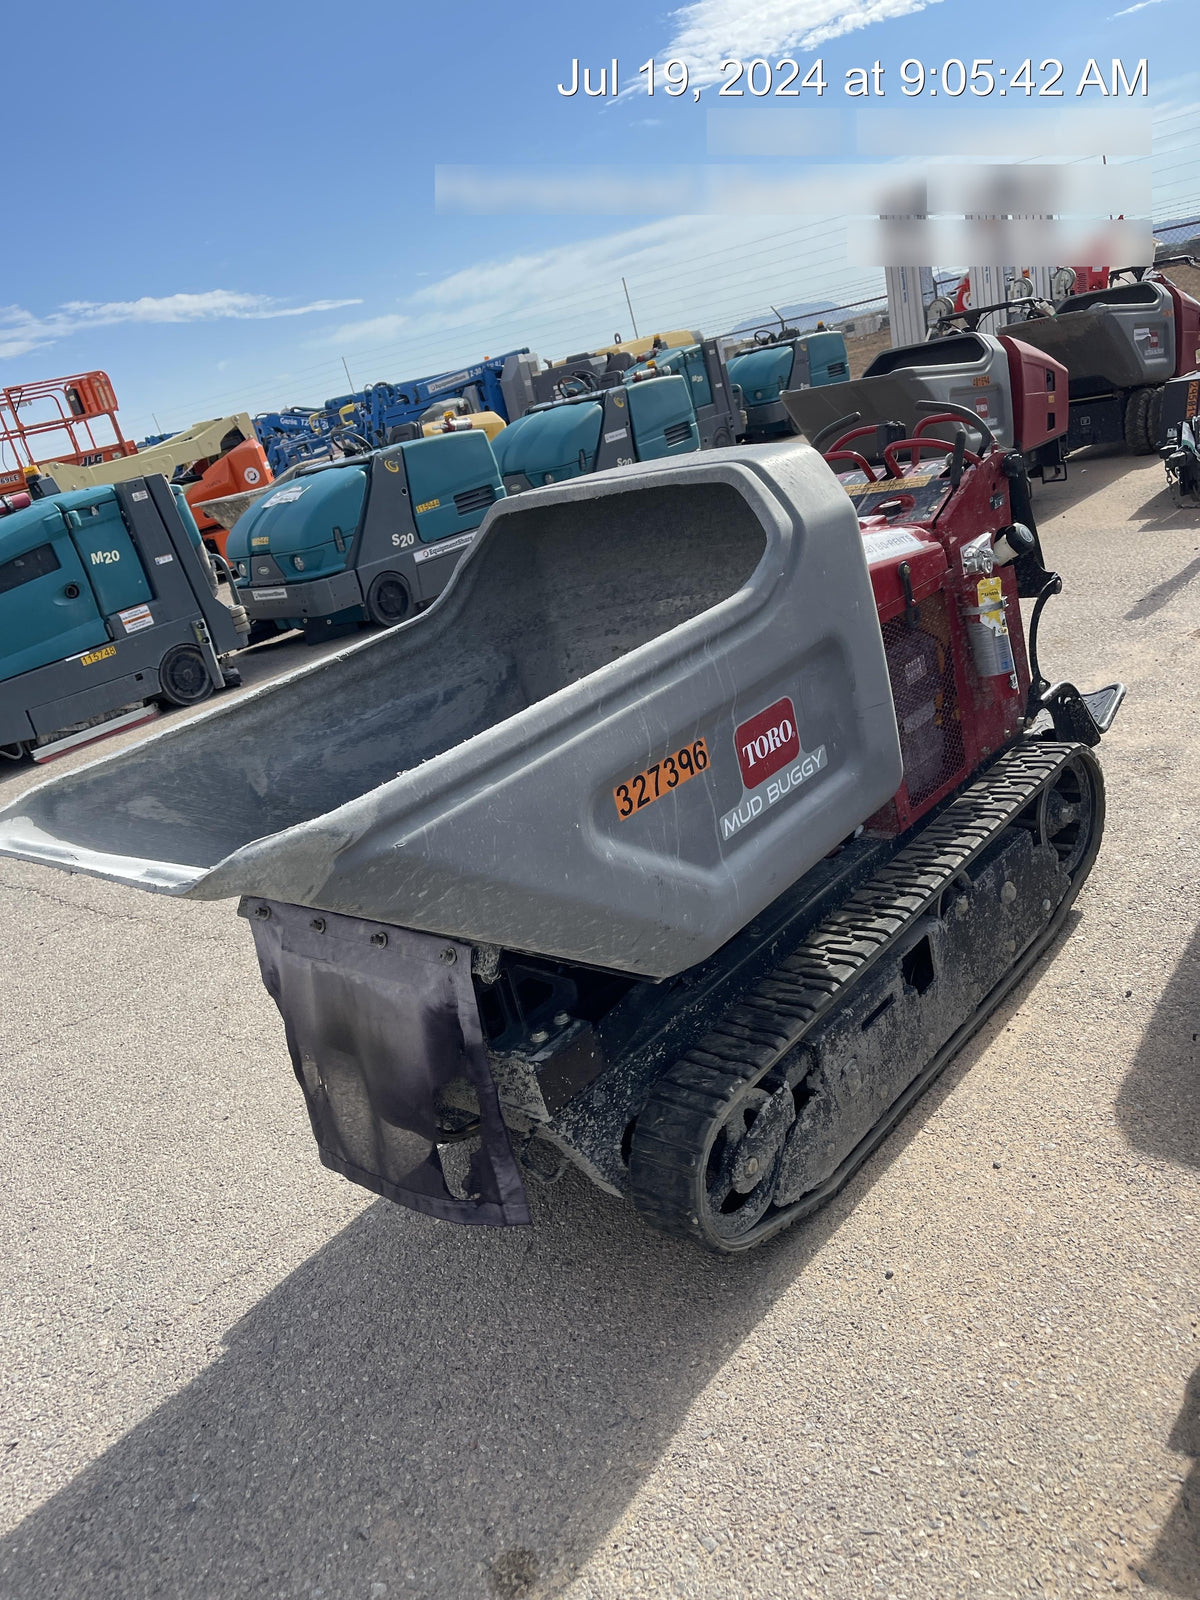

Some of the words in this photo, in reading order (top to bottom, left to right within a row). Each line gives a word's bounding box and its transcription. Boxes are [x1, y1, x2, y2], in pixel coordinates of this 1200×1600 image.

[81, 453, 104, 467] JLG
[391, 533, 414, 548] S20
[90, 549, 120, 565] M20
[82, 646, 116, 665] 115748
[742, 719, 793, 768] TORO
[616, 739, 708, 817] 327396
[723, 795, 763, 837] MUD
[766, 749, 823, 801] BUGGY
